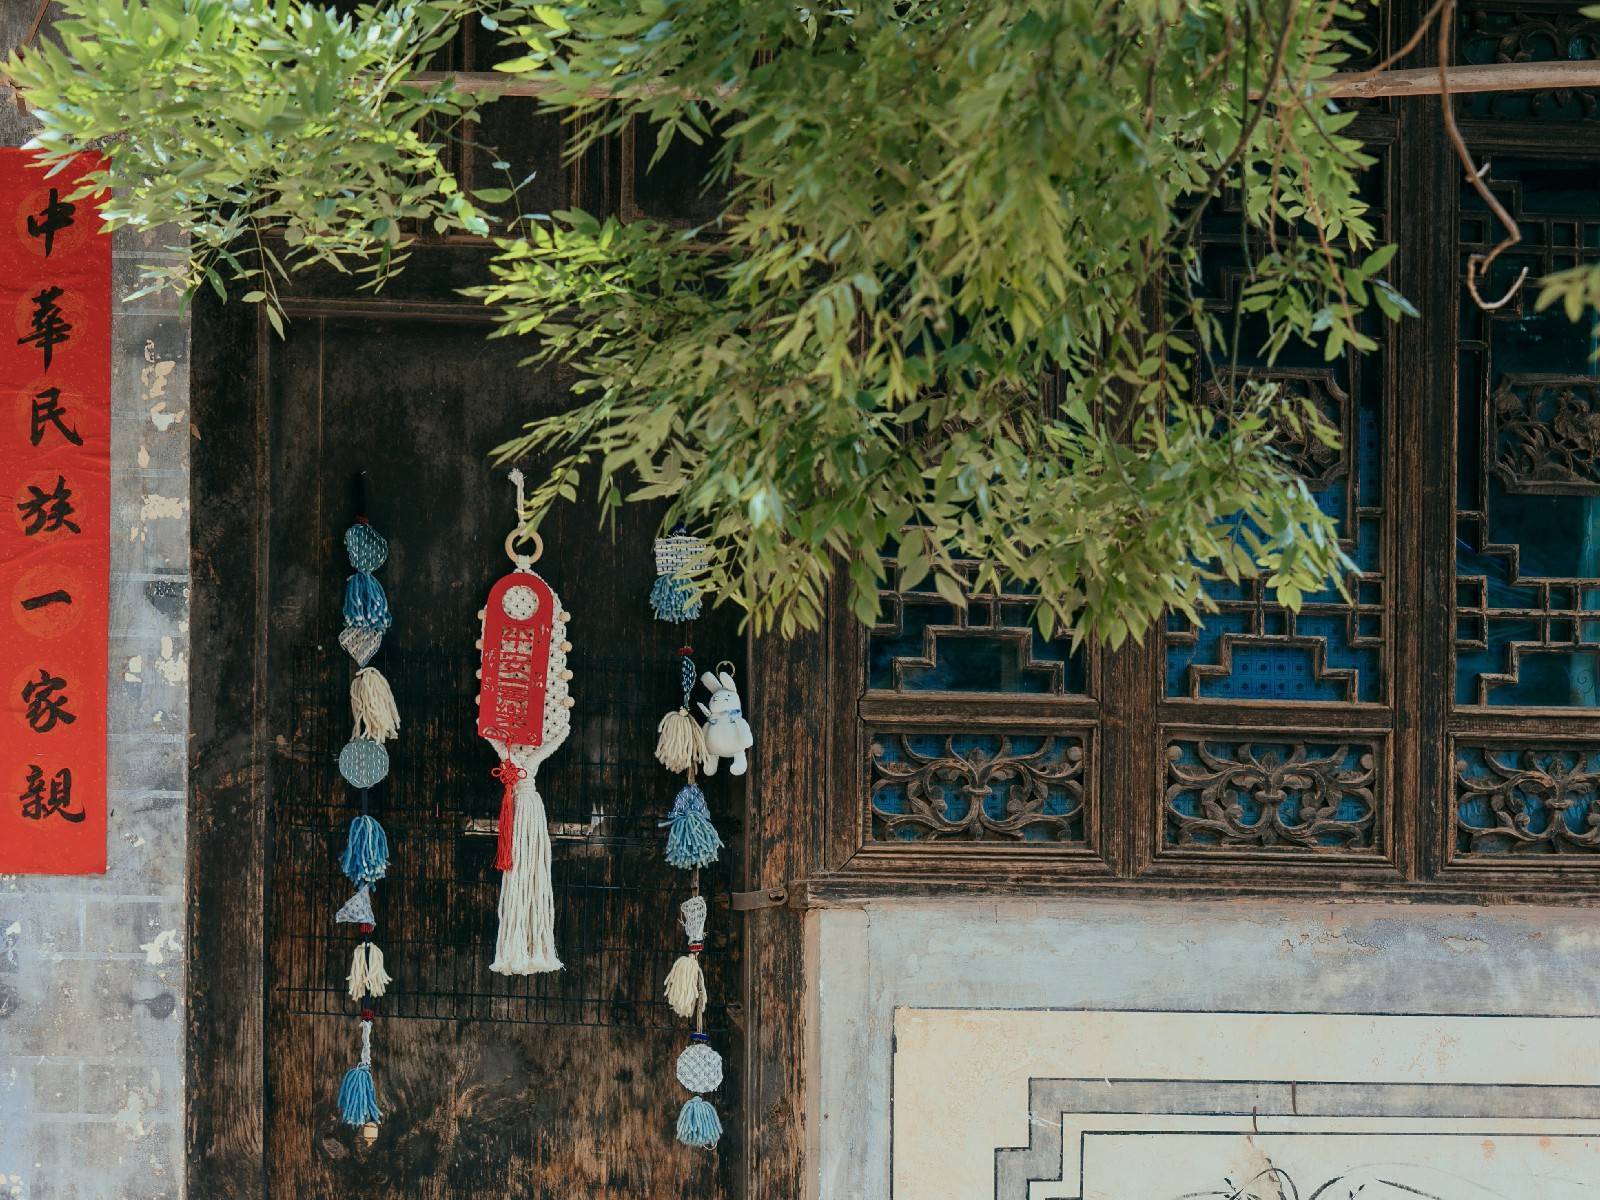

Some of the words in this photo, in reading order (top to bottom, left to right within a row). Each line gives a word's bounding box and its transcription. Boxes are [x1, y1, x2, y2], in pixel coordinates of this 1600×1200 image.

[18, 188, 86, 823] 中華民族一家親
